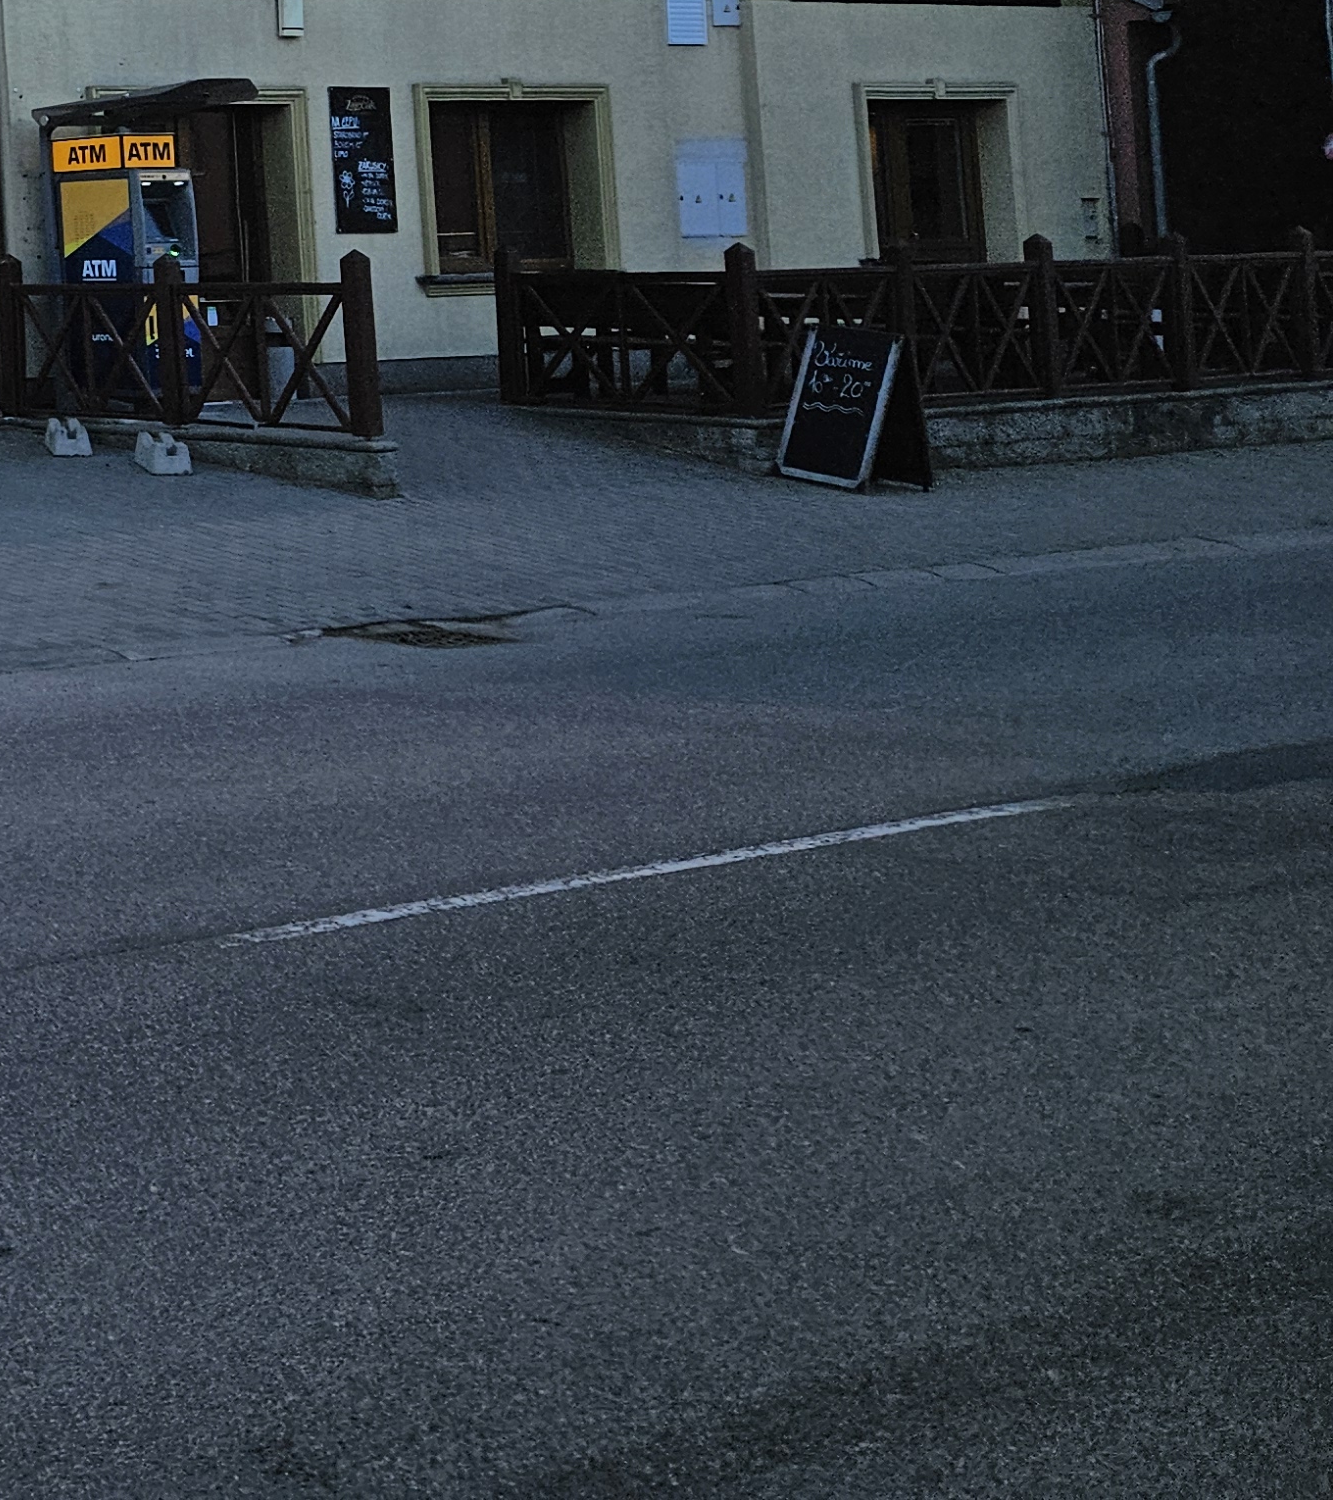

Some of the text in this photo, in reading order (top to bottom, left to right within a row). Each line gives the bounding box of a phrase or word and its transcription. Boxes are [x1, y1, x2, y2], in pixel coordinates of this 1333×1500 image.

[68, 144, 107, 165] ATM
[128, 142, 171, 161] ATM
[82, 260, 117, 277] ATM
